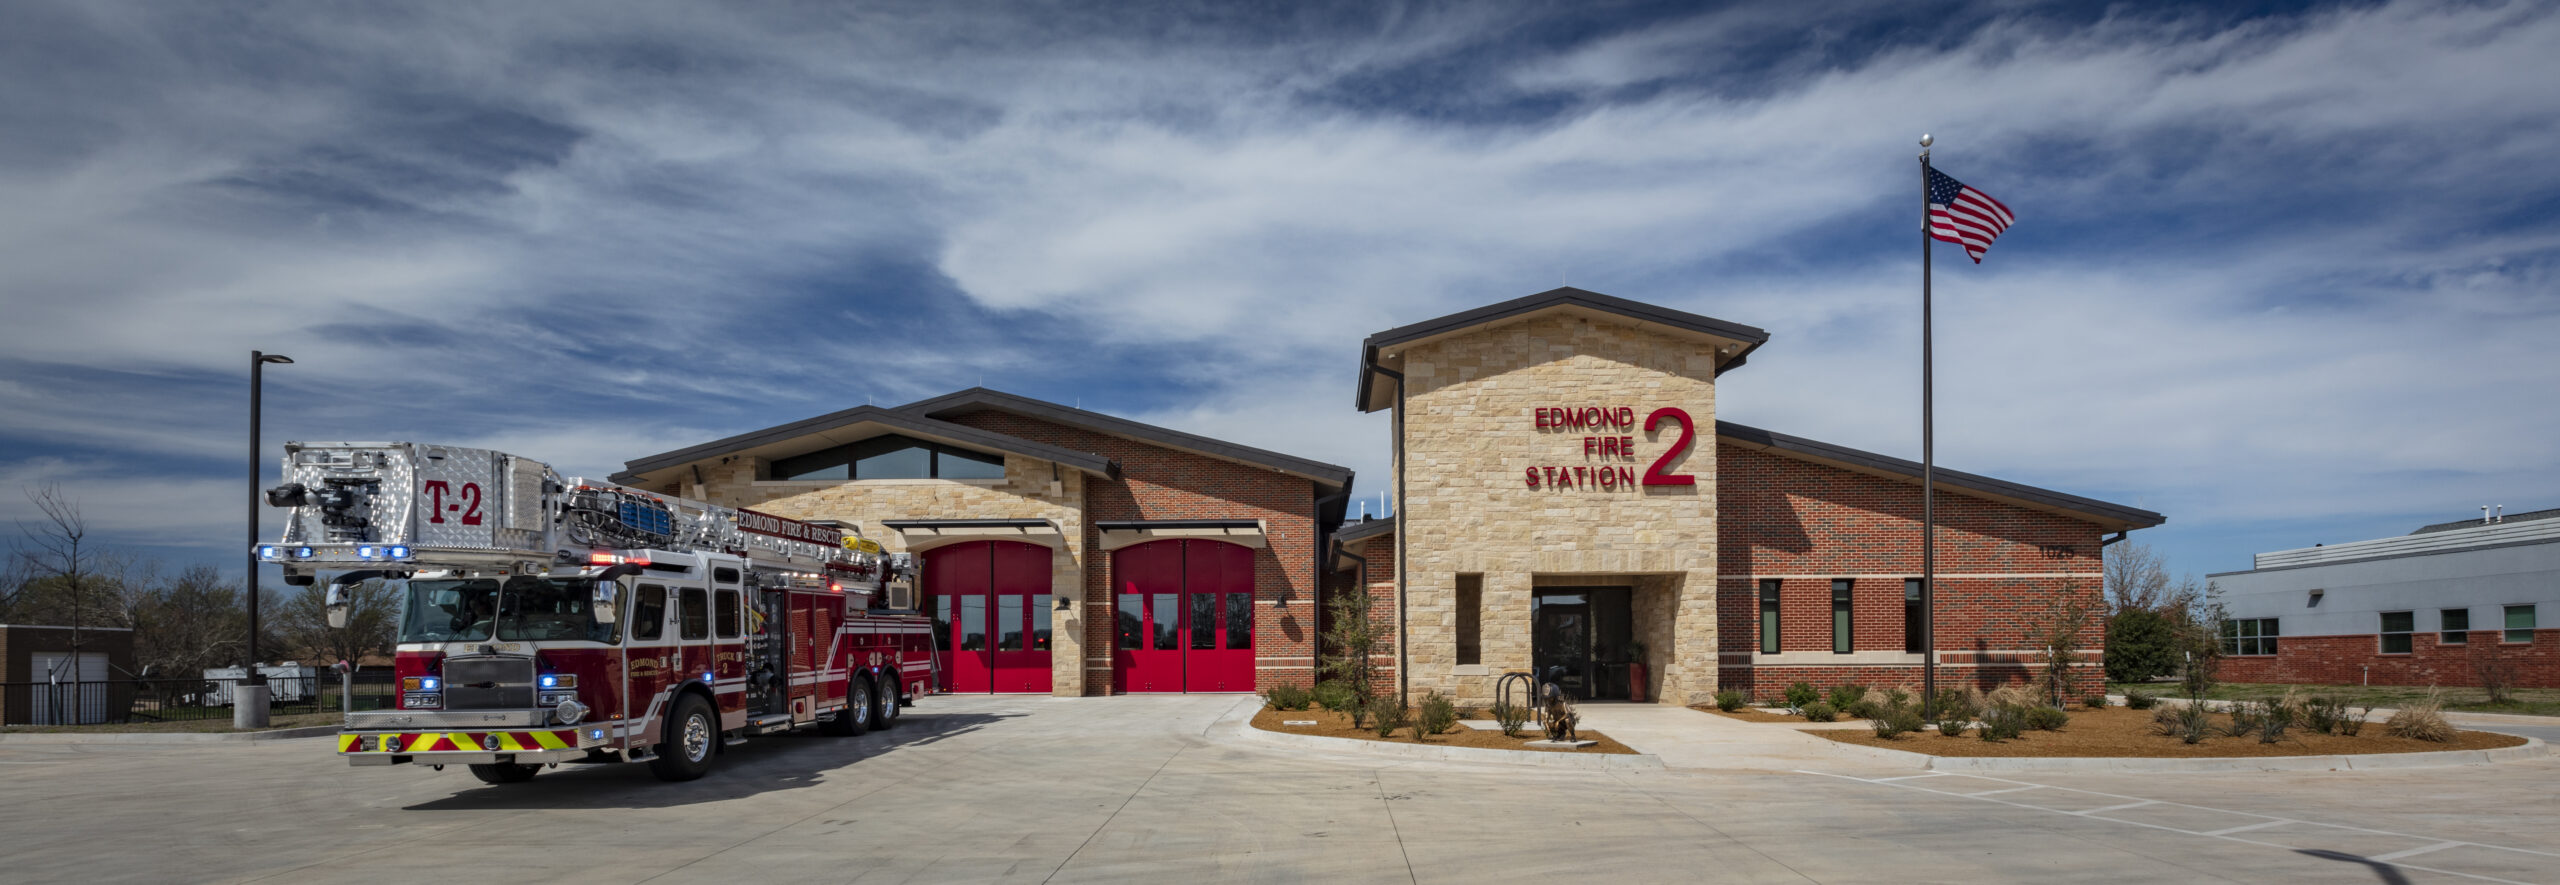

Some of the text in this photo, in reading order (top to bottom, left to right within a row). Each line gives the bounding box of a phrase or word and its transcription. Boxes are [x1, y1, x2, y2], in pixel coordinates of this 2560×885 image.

[1535, 407, 1634, 428] EDMOND
[1584, 436, 1635, 456] FIRE
[1642, 407, 1695, 486] 2
[1525, 466, 1634, 487] STATION
[424, 480, 483, 526] T-2
[739, 512, 841, 545] EDMOND FIRE & RESCUE
[630, 657, 659, 670] EDMOND
[716, 652, 735, 662] TRUCK
[722, 662, 728, 674] 2
